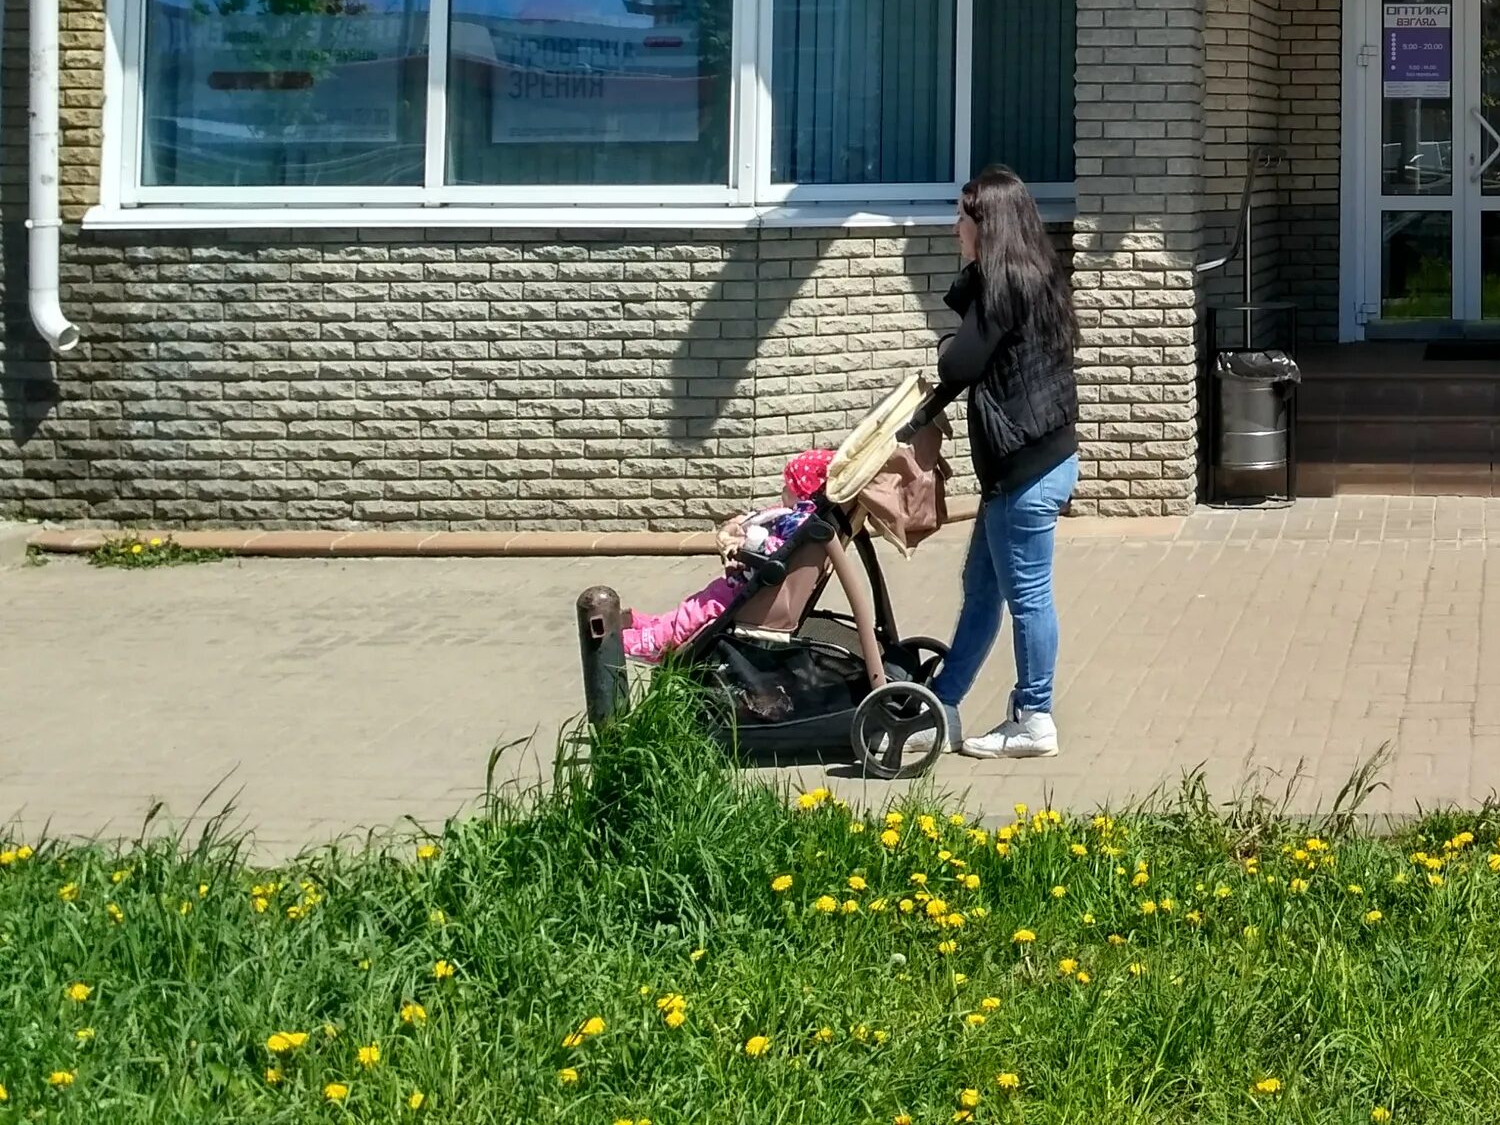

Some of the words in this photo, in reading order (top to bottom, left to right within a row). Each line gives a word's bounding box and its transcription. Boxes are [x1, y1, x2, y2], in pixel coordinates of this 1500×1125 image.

[1386, 6, 1448, 16] ОПТИКА
[1396, 17, 1437, 27] ВЗГЛЯД
[508, 71, 605, 100] ЗРЕНИЯ
